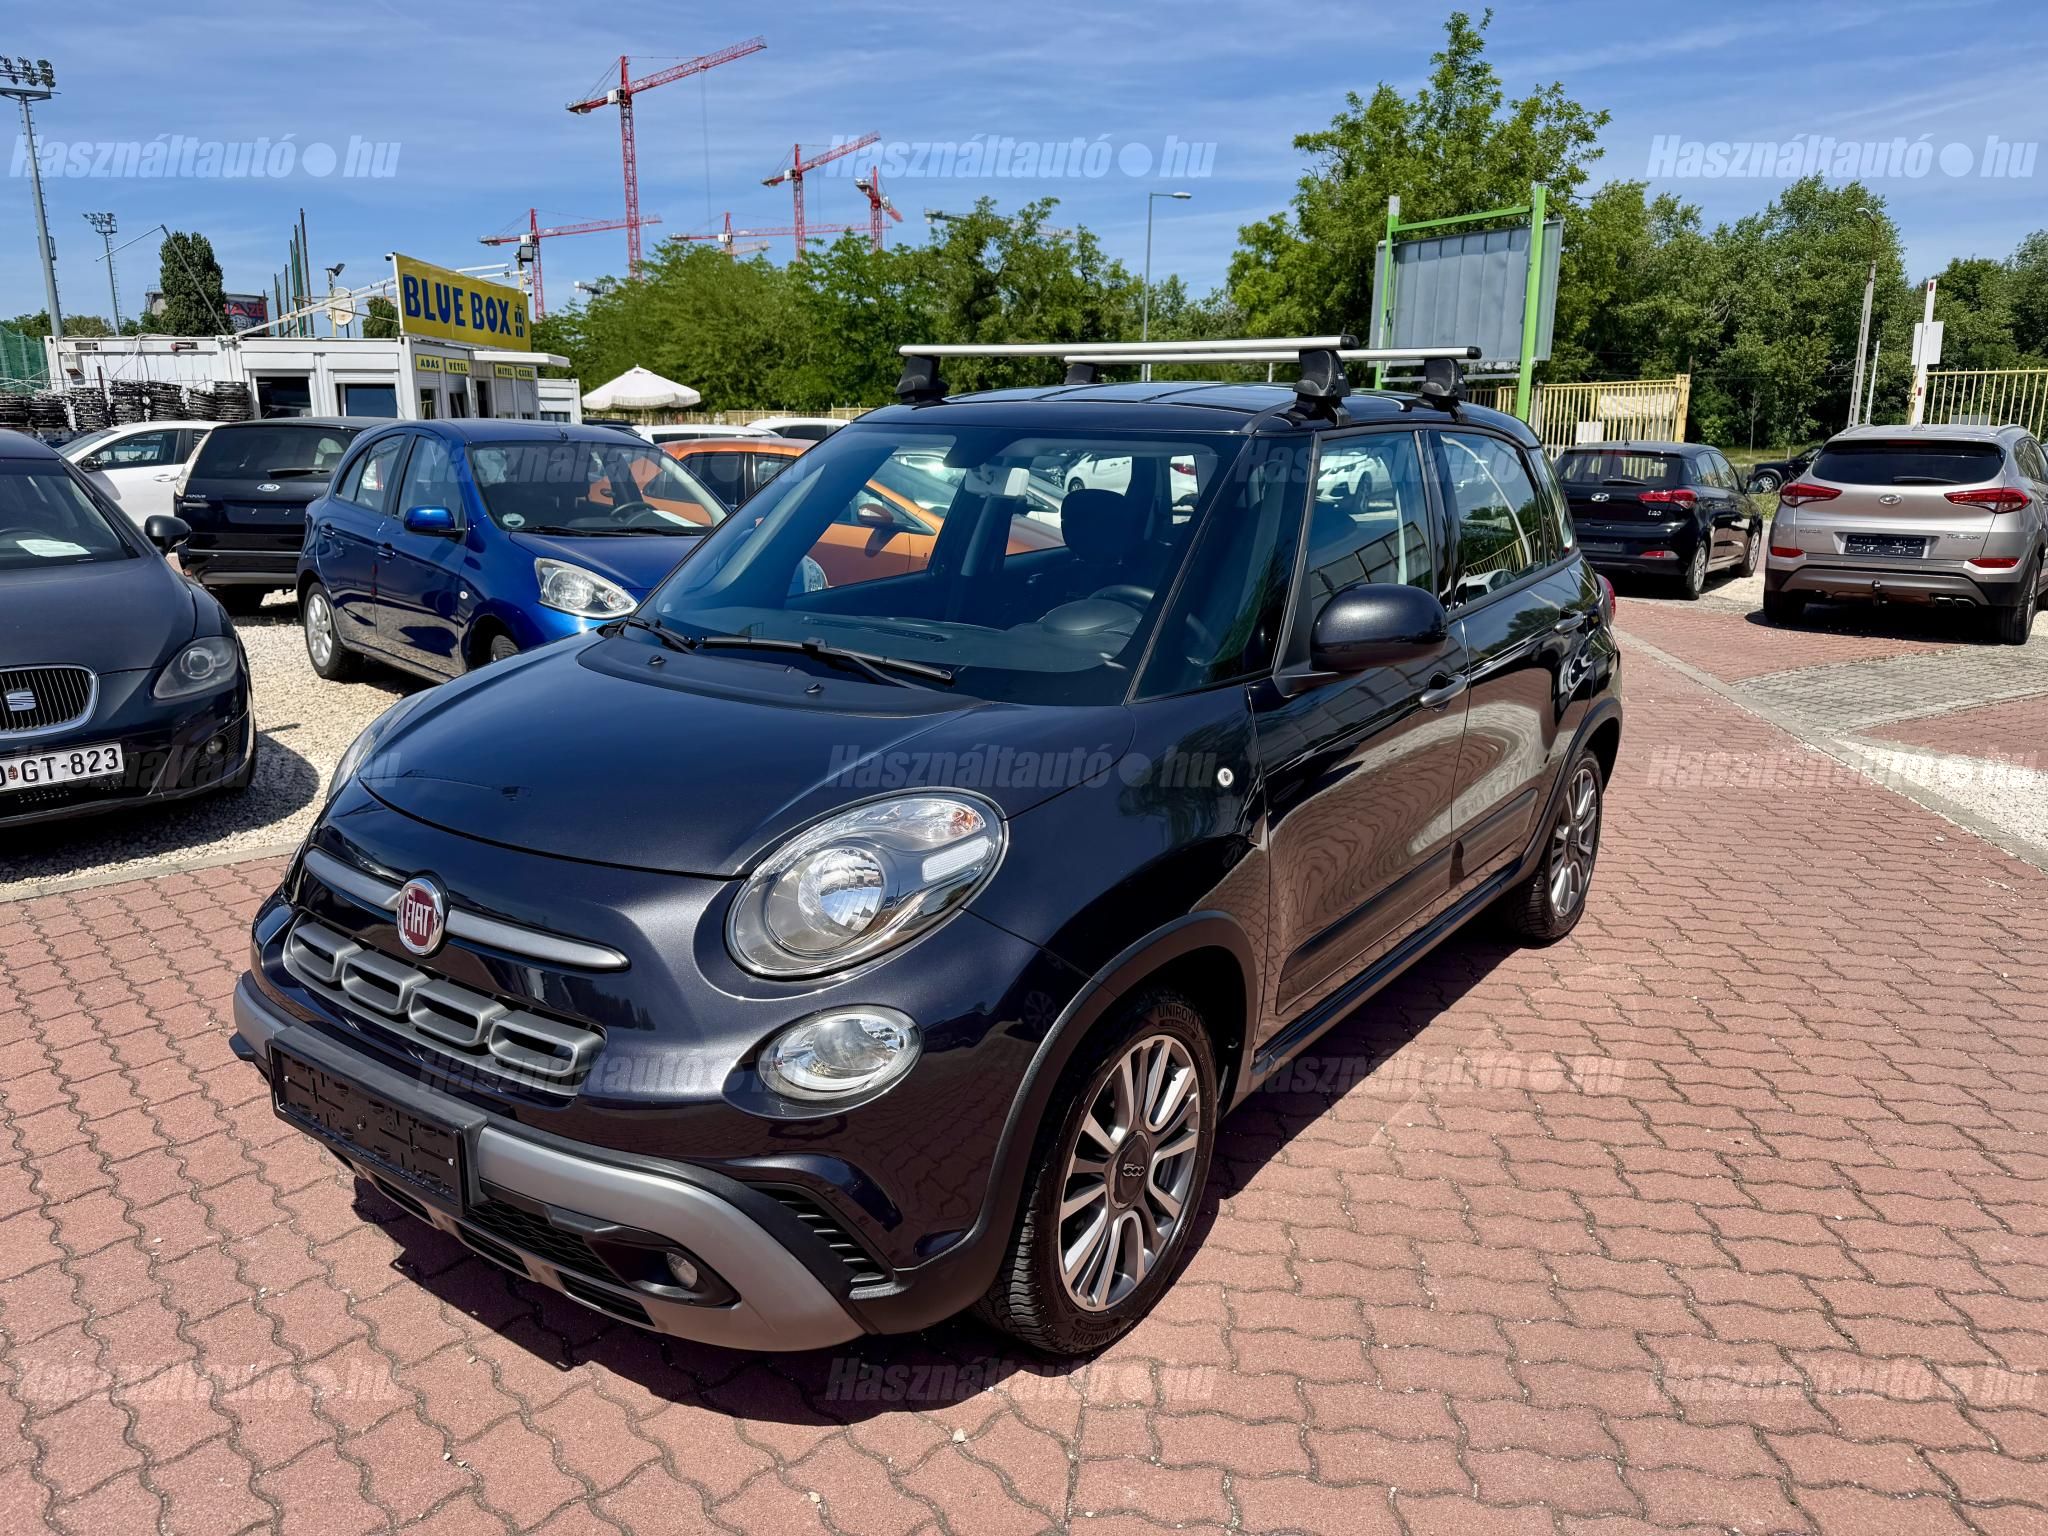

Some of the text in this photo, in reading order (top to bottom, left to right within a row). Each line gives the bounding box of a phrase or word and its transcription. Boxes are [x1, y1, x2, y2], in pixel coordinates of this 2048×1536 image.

[403, 274, 512, 336] BLUE BOX
[21, 747, 118, 783] GT-823
[405, 898, 432, 937] FIAT
[1158, 1004, 1201, 1034] UNIROYAL
